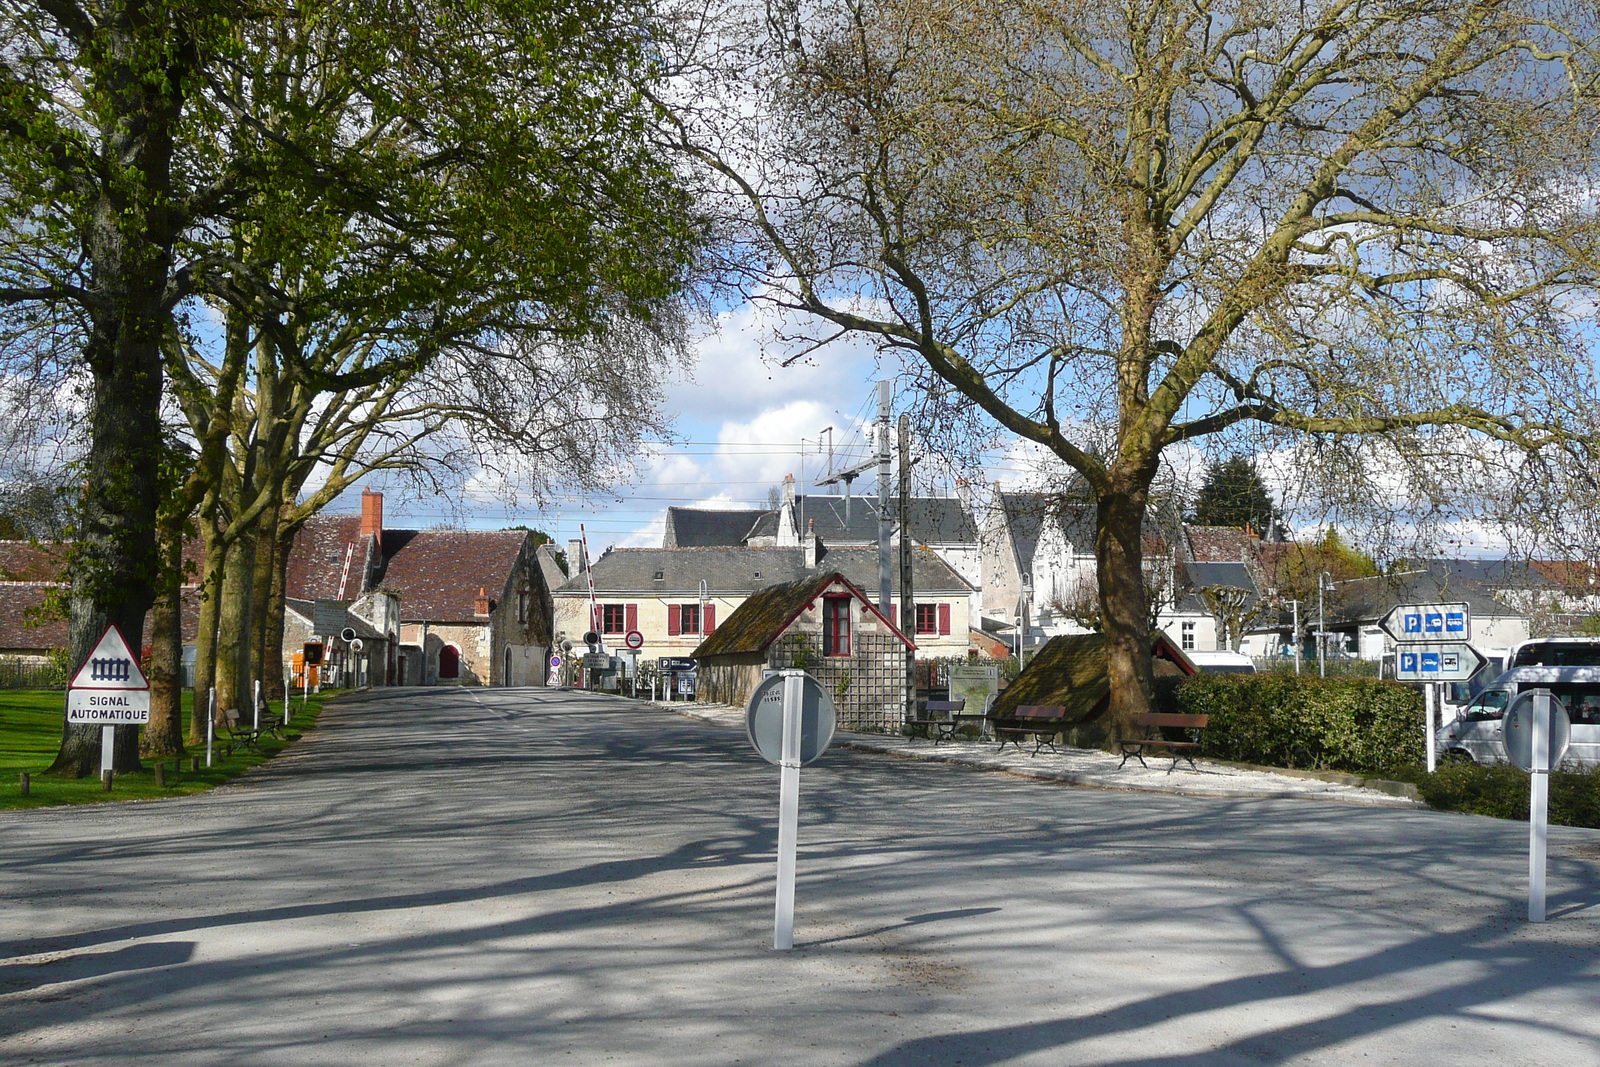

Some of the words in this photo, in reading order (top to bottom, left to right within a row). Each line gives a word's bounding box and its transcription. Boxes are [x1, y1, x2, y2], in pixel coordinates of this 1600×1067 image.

[1409, 617, 1418, 630] P
[1405, 656, 1413, 669] P
[89, 697, 130, 706] SIGNAL
[70, 709, 147, 720] AUTOMATIQUE
